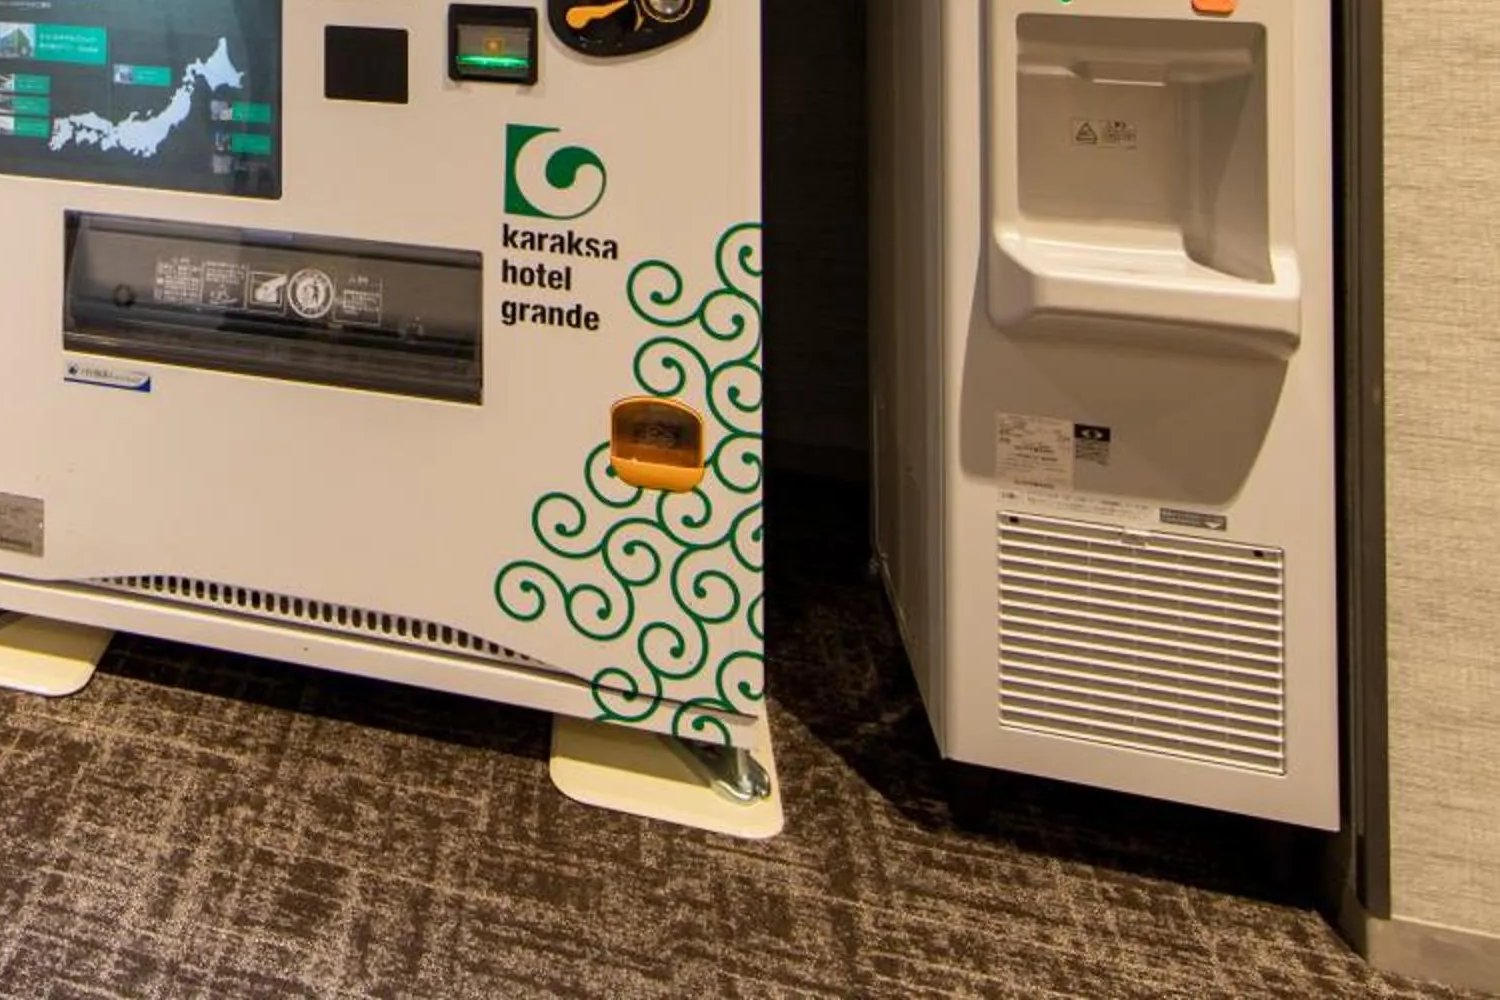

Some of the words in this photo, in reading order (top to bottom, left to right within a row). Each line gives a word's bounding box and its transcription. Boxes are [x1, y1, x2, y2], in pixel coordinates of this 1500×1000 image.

[502, 223, 618, 260] karaksa
[501, 259, 572, 291] hotel
[501, 300, 600, 331] grande
